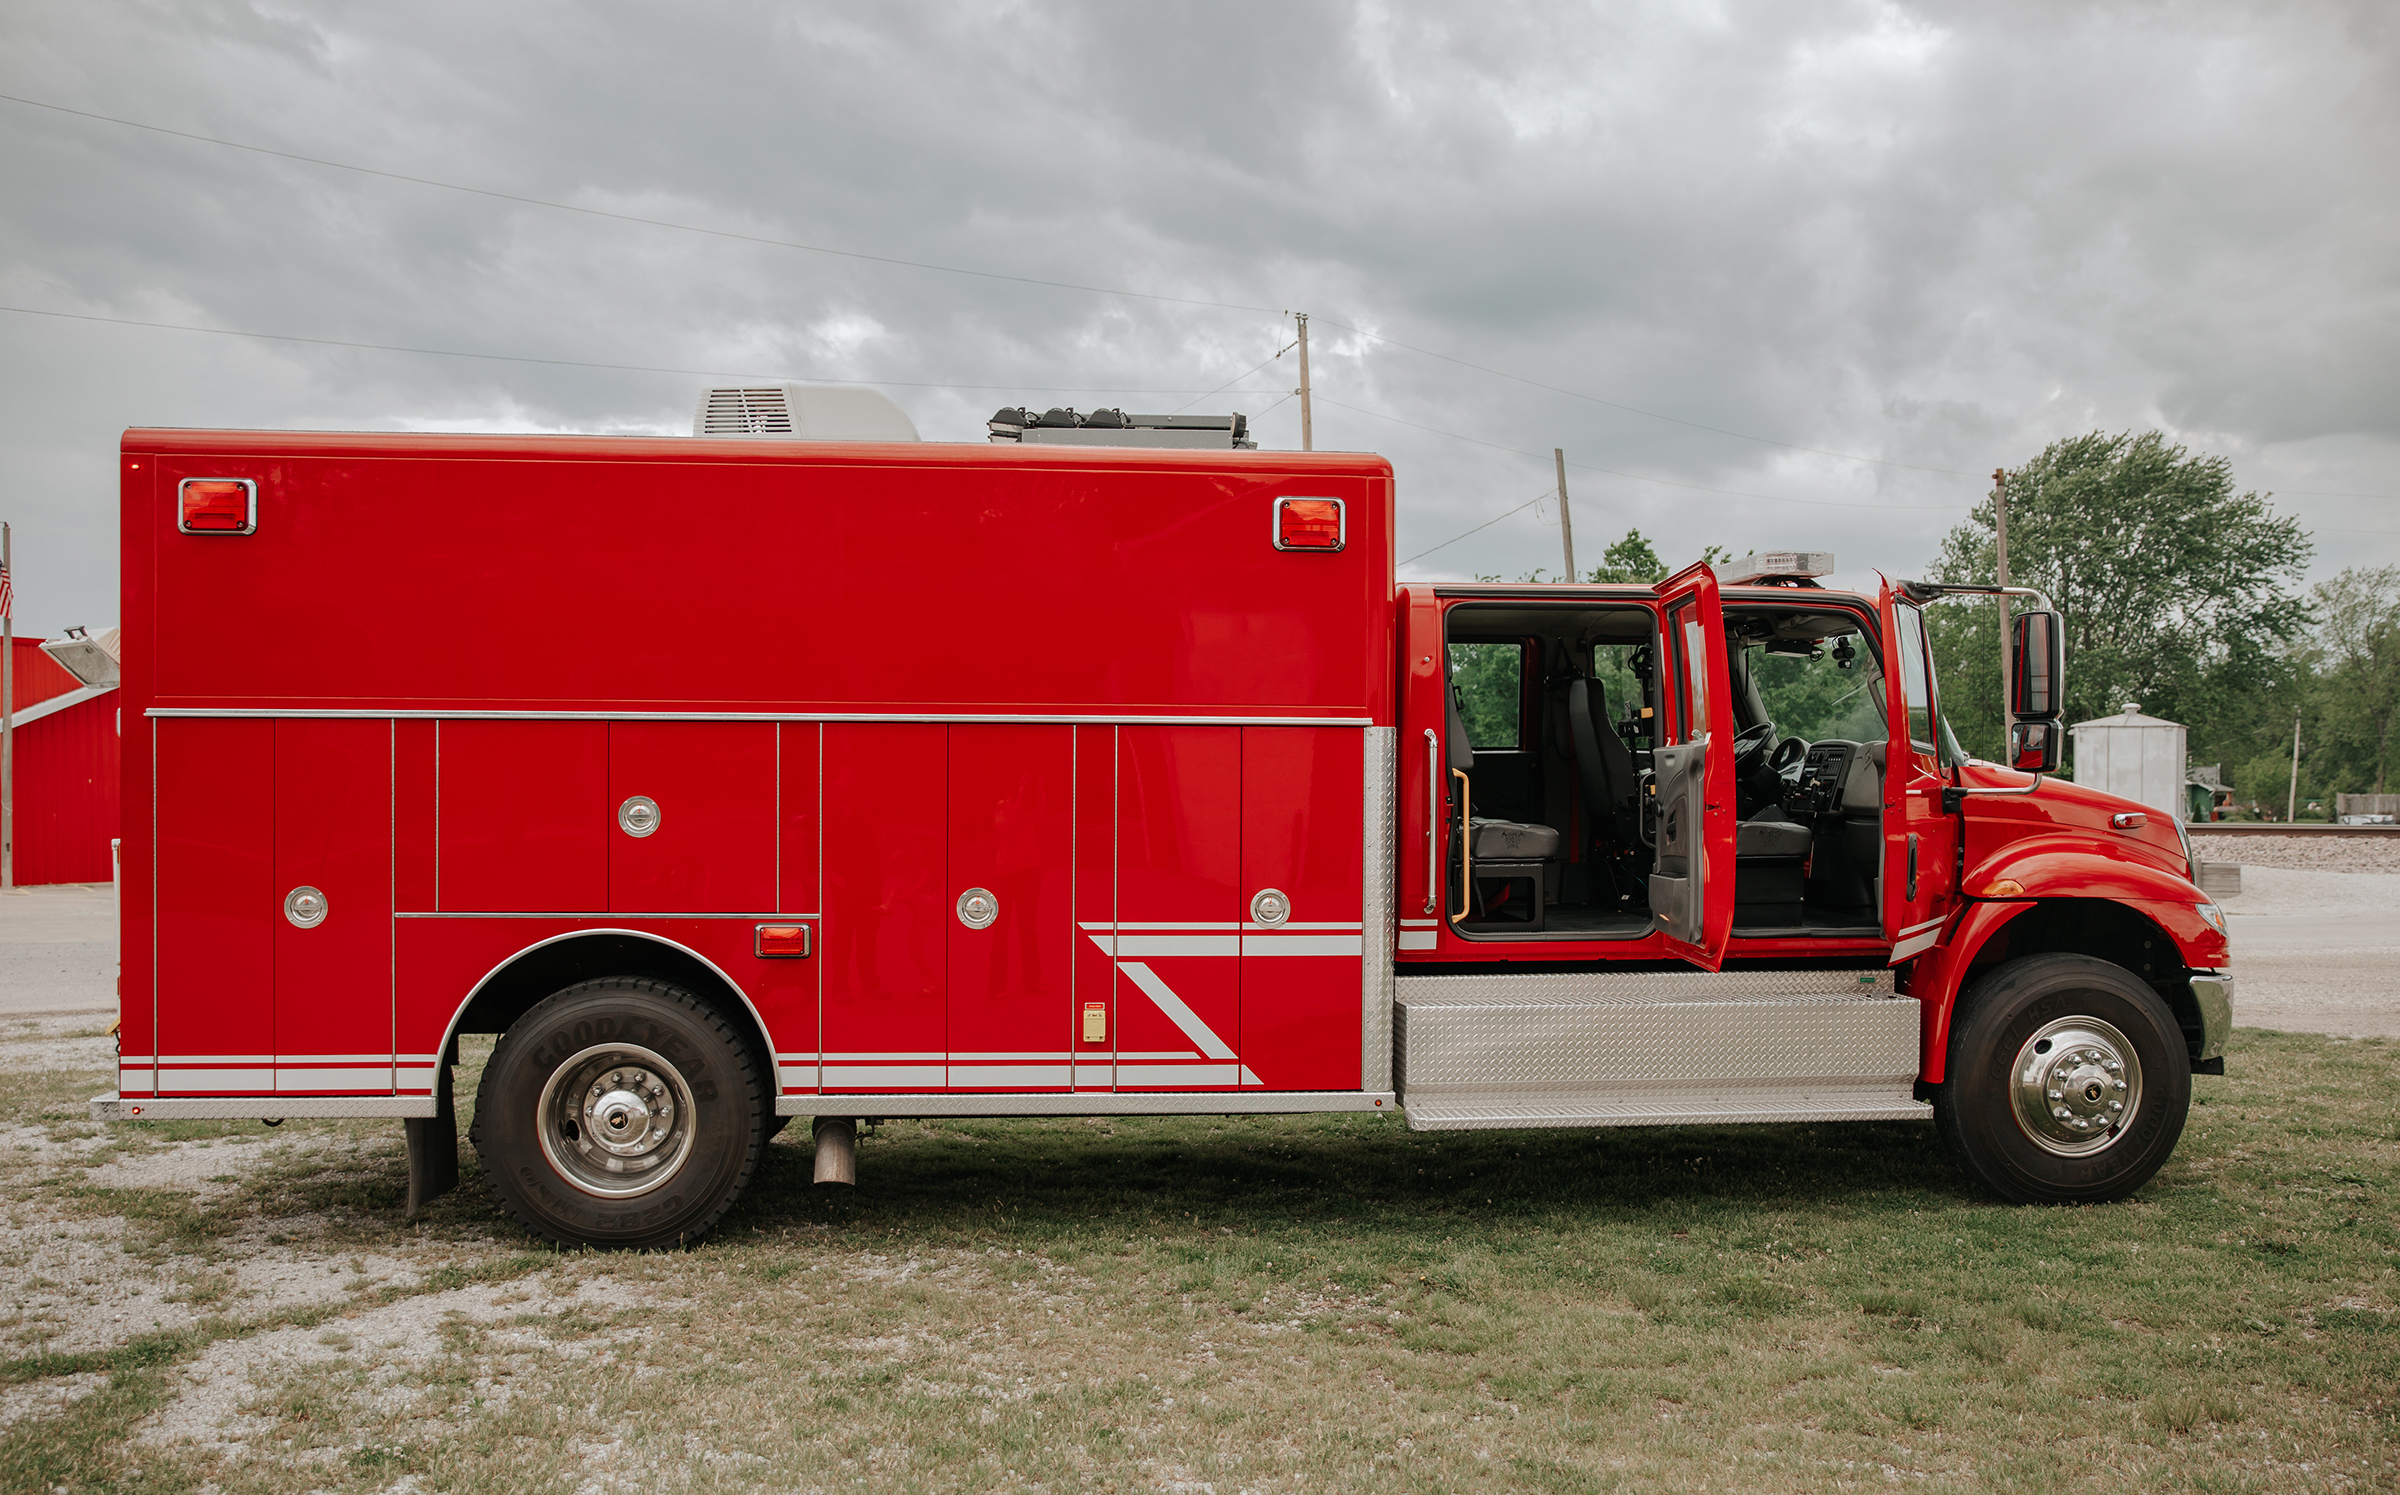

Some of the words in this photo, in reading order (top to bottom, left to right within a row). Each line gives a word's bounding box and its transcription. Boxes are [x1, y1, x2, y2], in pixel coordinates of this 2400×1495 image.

[2027, 994, 2068, 1024] HSA
[519, 1166, 583, 1220] MSD
[596, 1194, 684, 1230] G282
